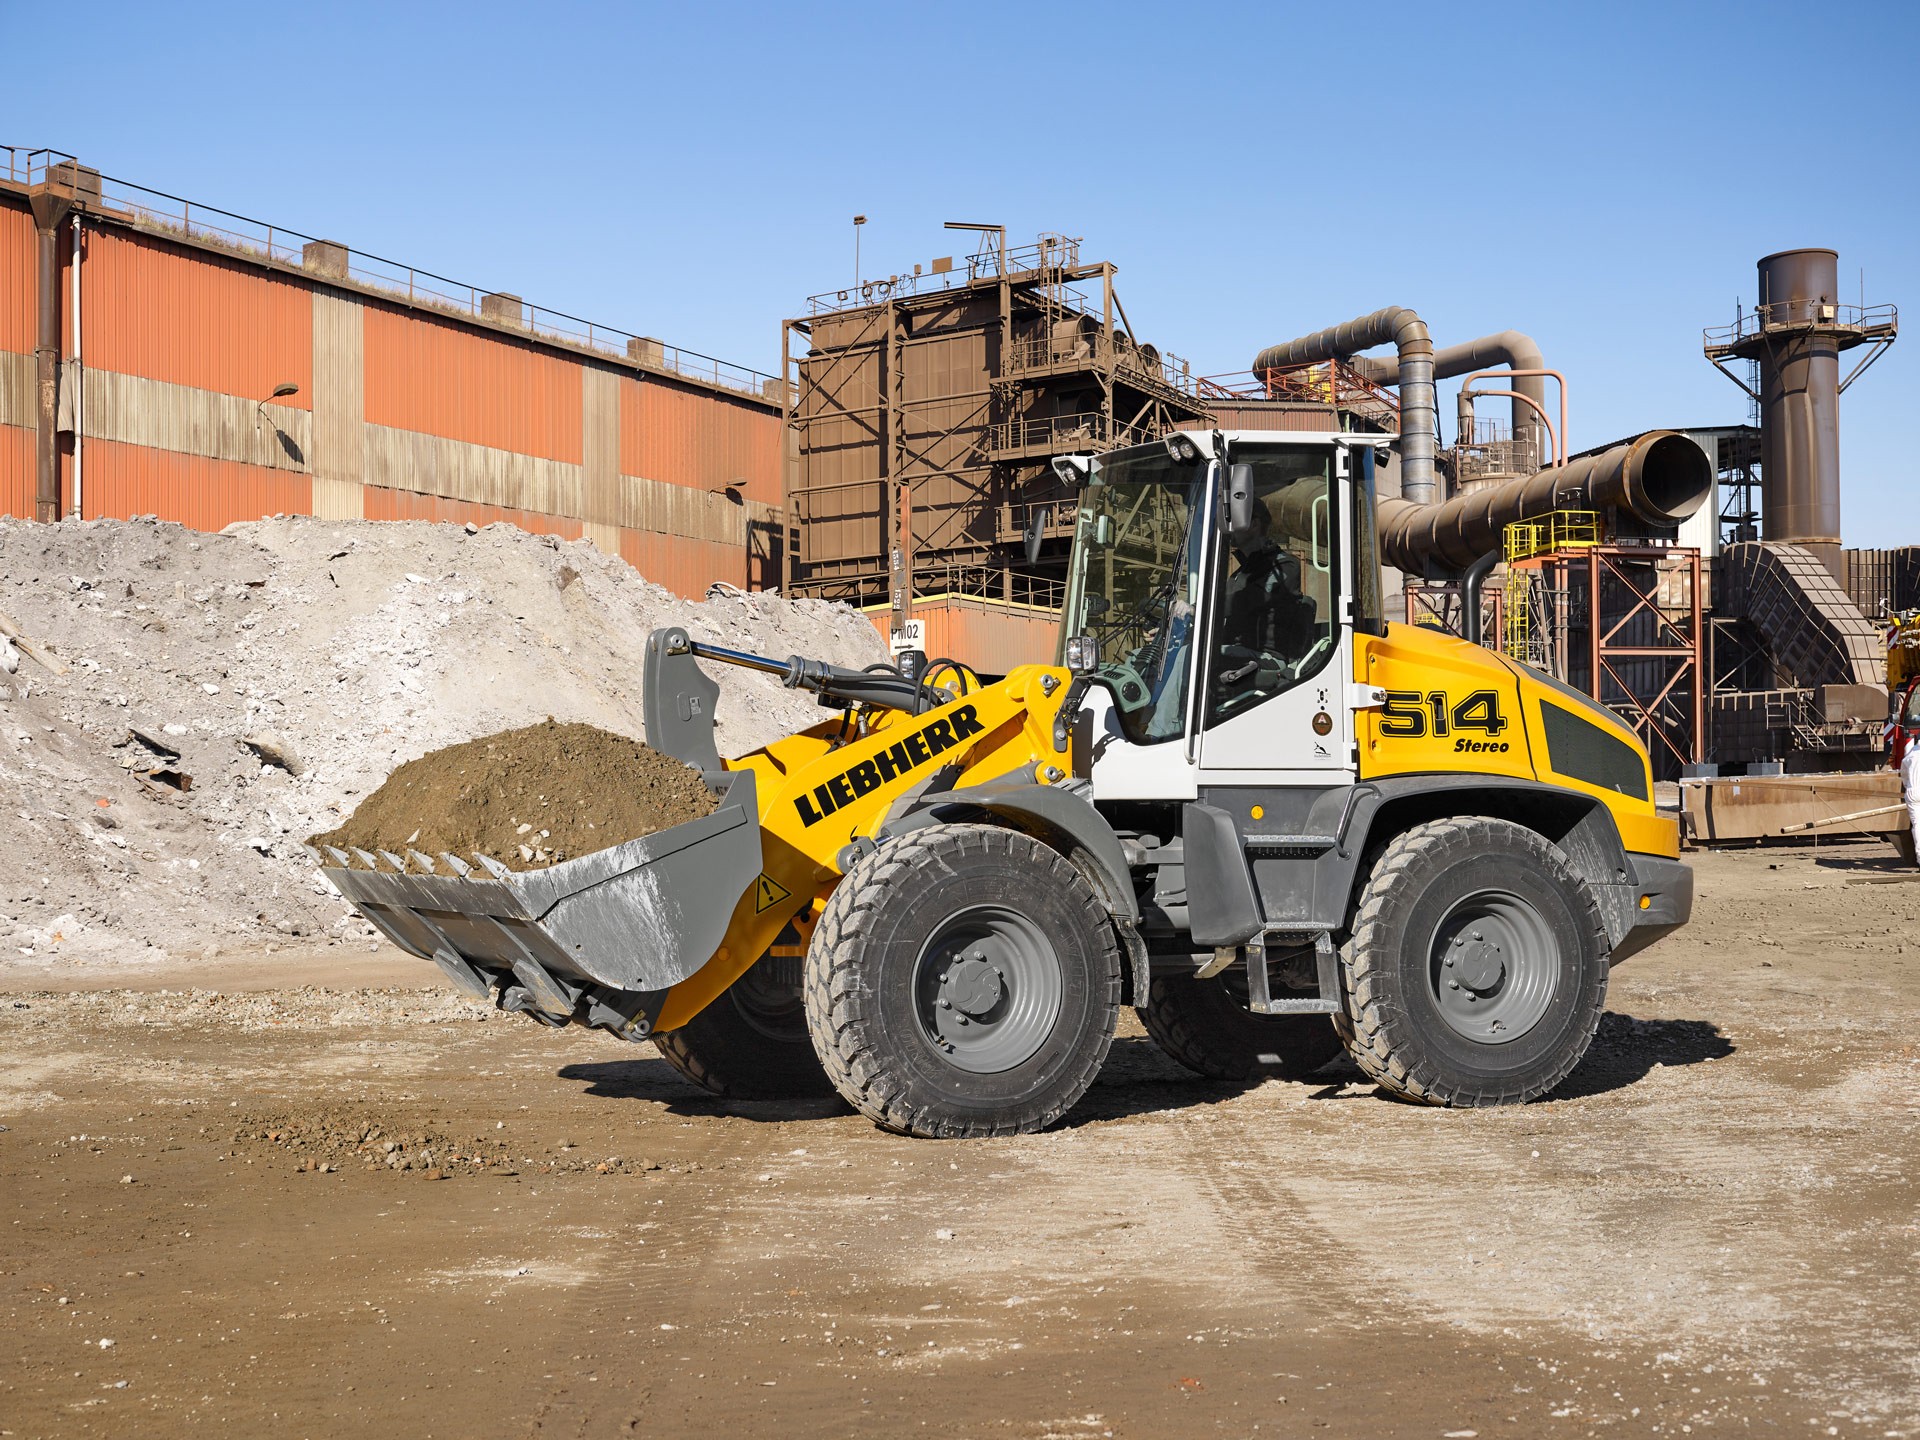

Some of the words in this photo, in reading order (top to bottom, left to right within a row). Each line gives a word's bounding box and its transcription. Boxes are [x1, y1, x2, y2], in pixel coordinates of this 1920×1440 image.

[1379, 690, 1508, 738] 514
[793, 704, 986, 828] LIEBHERR
[1453, 738, 1510, 753] Stereo
